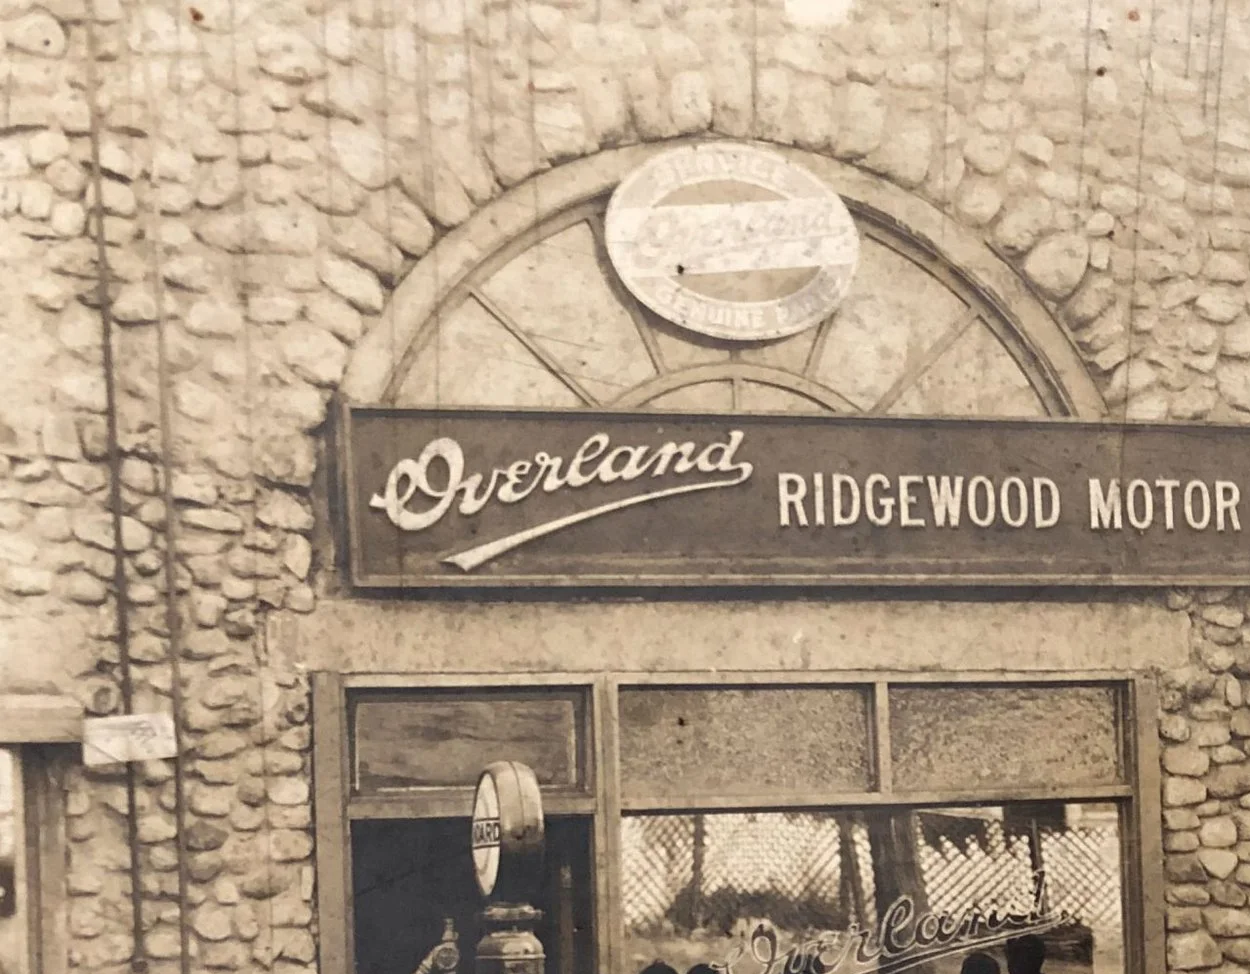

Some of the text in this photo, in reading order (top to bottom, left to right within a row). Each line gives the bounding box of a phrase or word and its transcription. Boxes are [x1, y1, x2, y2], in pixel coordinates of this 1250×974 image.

[654, 284, 766, 328] GENUINE
[368, 429, 754, 532] Overland
[777, 472, 1061, 529] RIDGEWOOD
[1088, 477, 1241, 531] MOTOR
